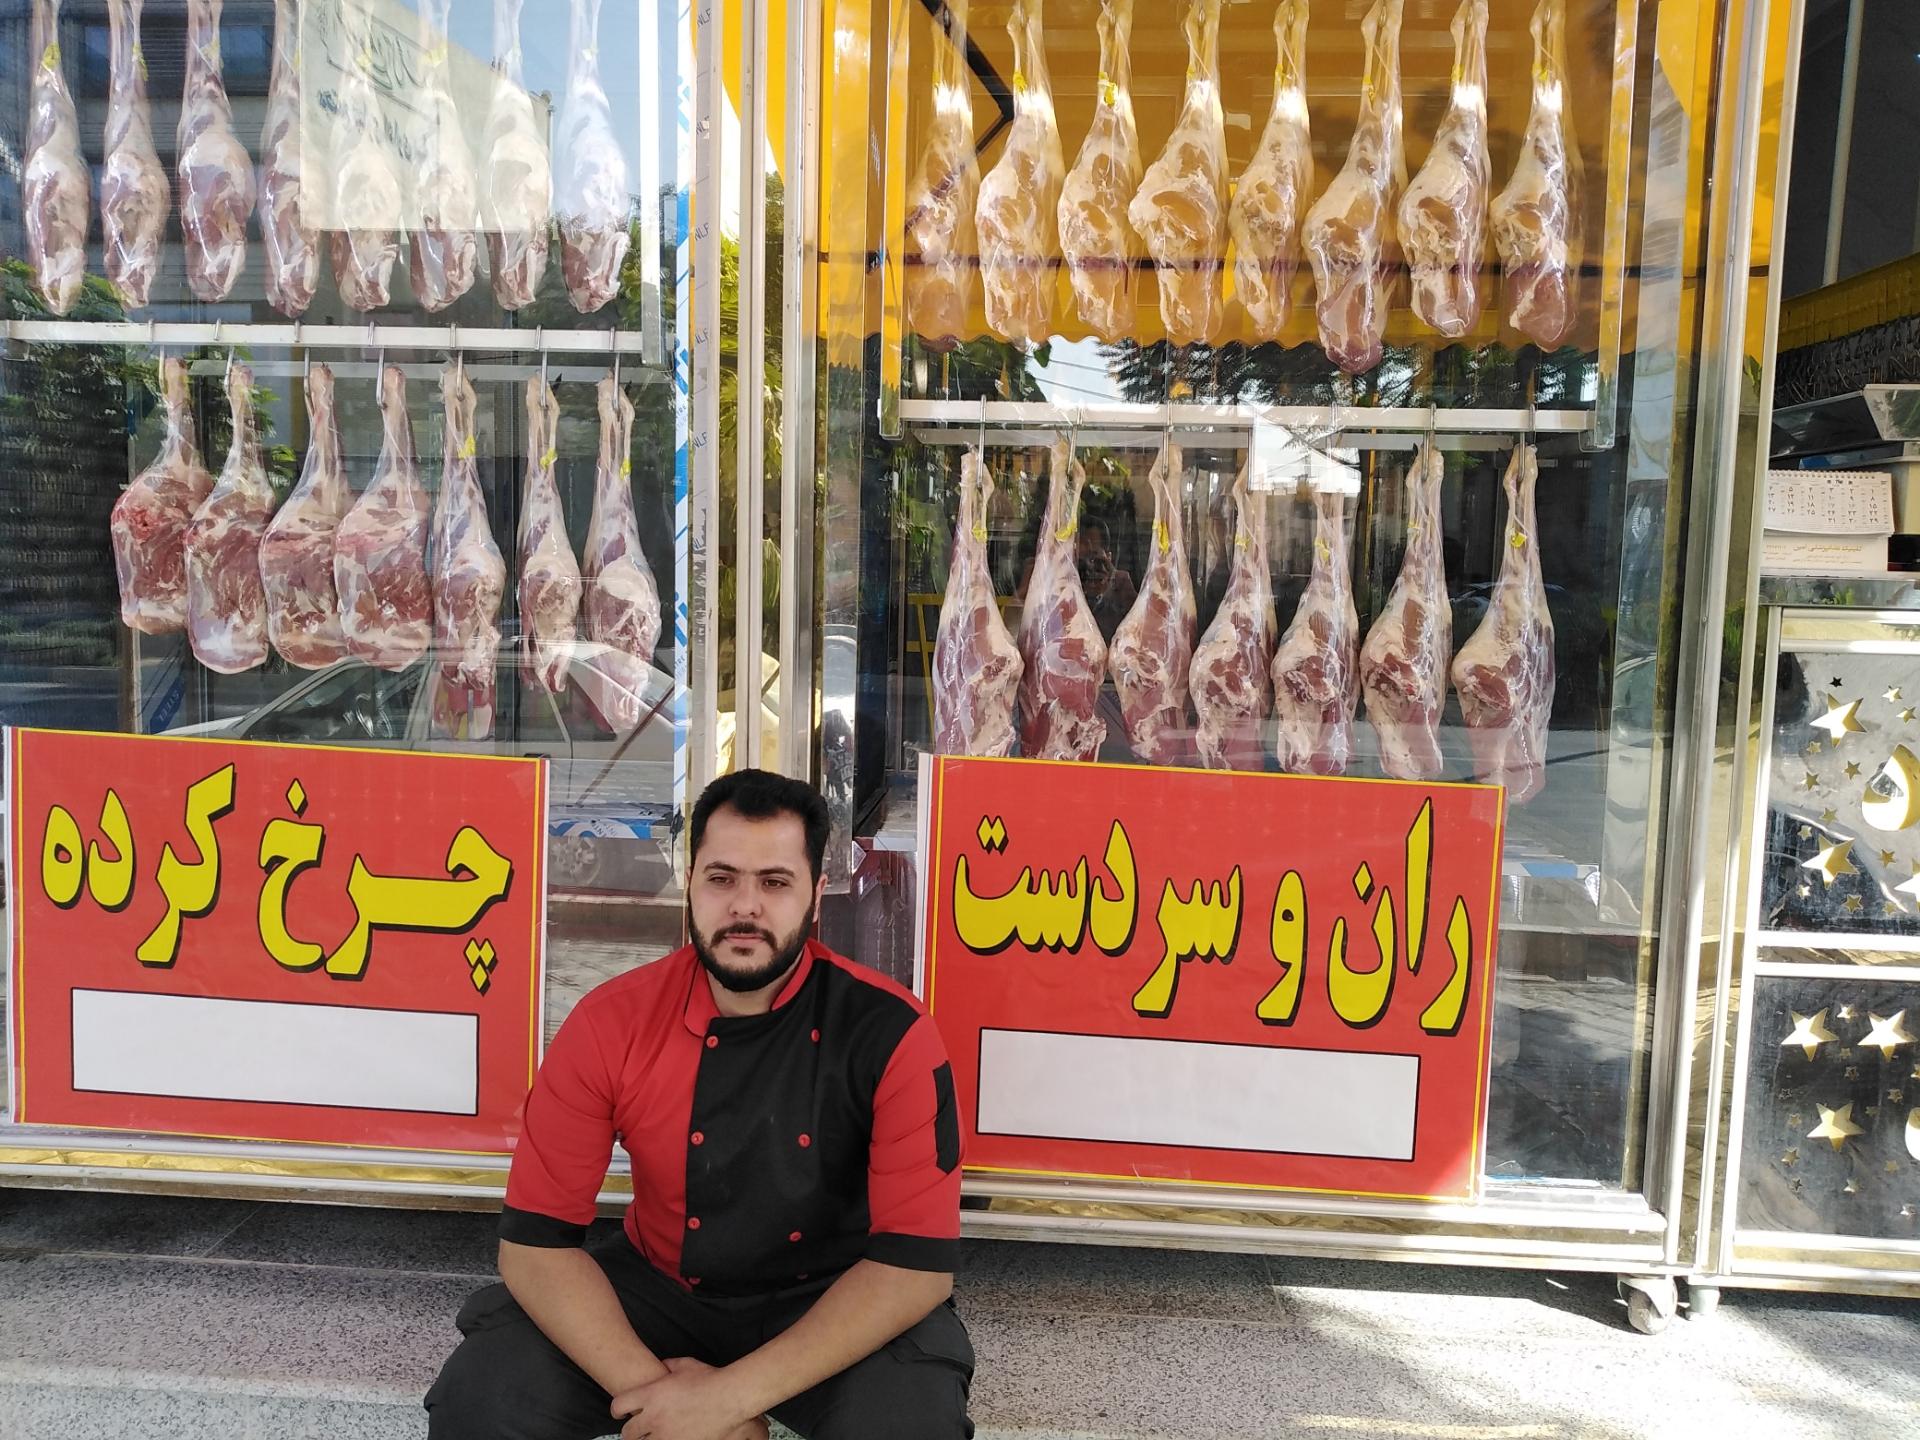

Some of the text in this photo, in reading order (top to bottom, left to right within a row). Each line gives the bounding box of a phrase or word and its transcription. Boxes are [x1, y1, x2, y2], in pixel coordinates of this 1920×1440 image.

[41, 763, 515, 996] چرخ کرده
[1256, 869, 1308, 1025] و
[1326, 797, 1472, 1035] ران
